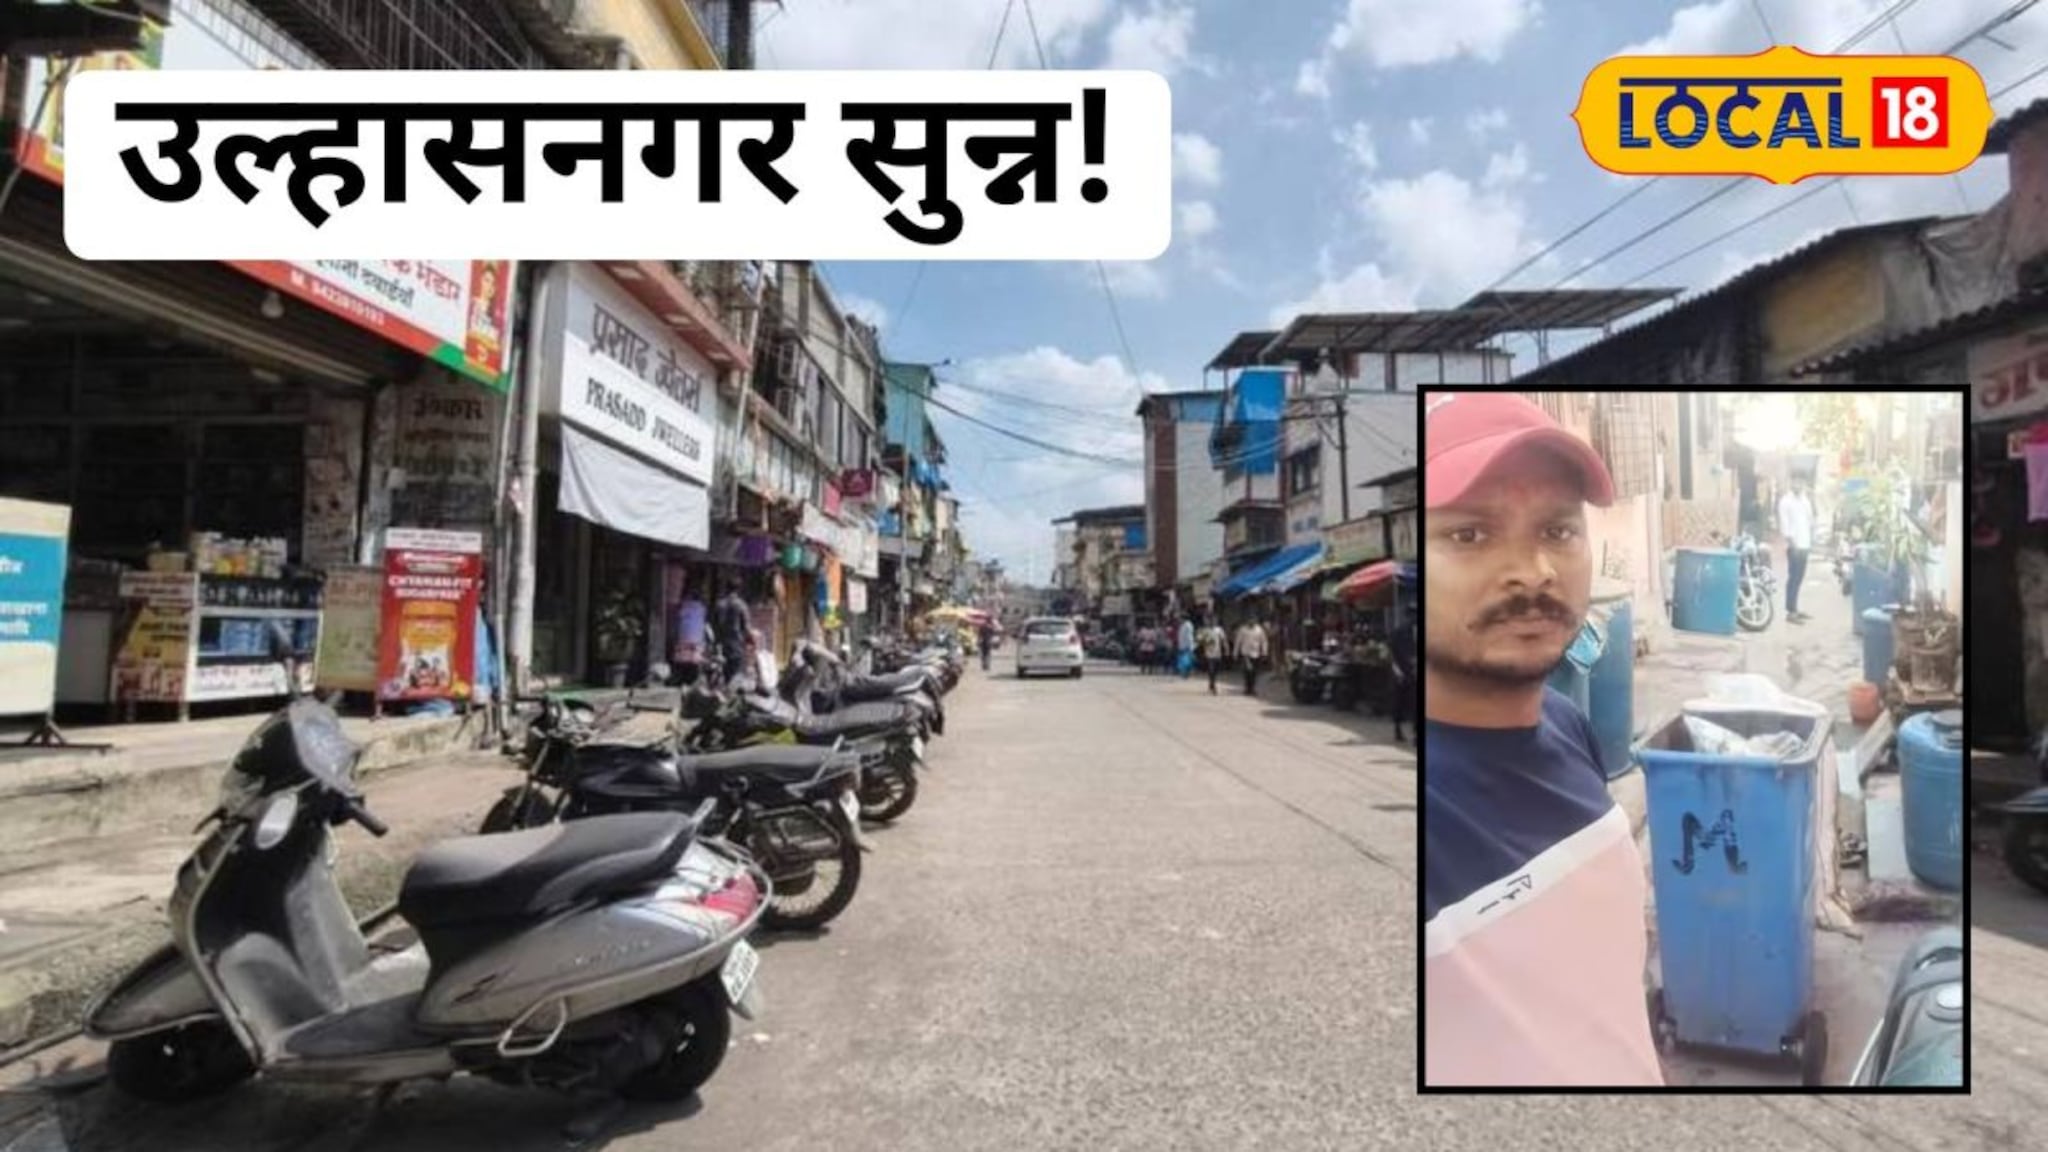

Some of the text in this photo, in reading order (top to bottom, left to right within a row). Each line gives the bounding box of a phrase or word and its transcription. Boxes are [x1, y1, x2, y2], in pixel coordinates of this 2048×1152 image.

[589, 302, 651, 380] प्रसाद
[586, 377, 647, 432] PRASADD
[1671, 809, 1749, 876] M
